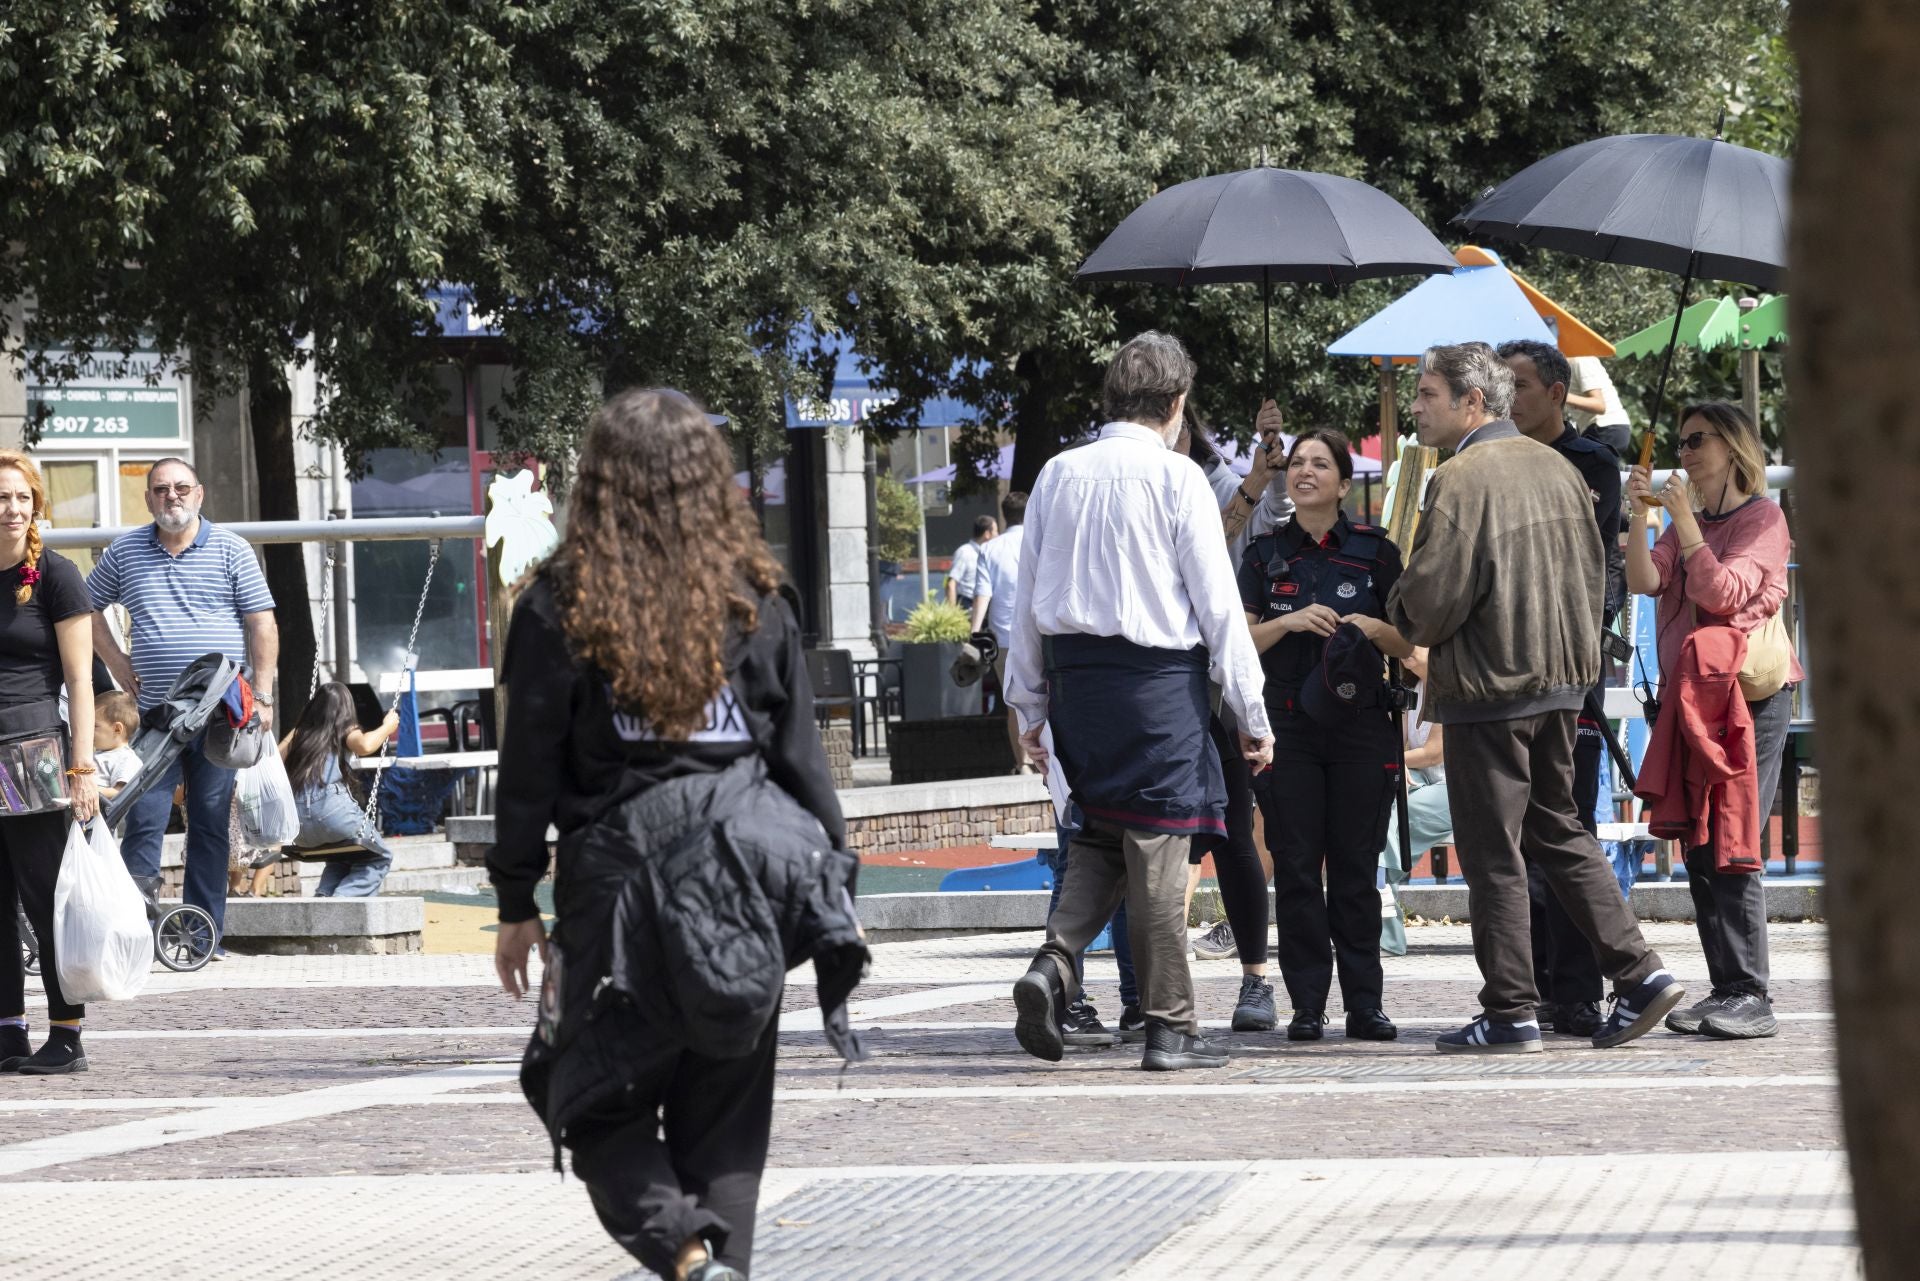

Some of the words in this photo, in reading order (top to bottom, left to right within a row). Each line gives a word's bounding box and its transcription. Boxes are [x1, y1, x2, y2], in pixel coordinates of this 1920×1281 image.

[52, 416, 89, 433] 907
[93, 416, 129, 433] 263
[1270, 602, 1292, 611] POLIZIA
